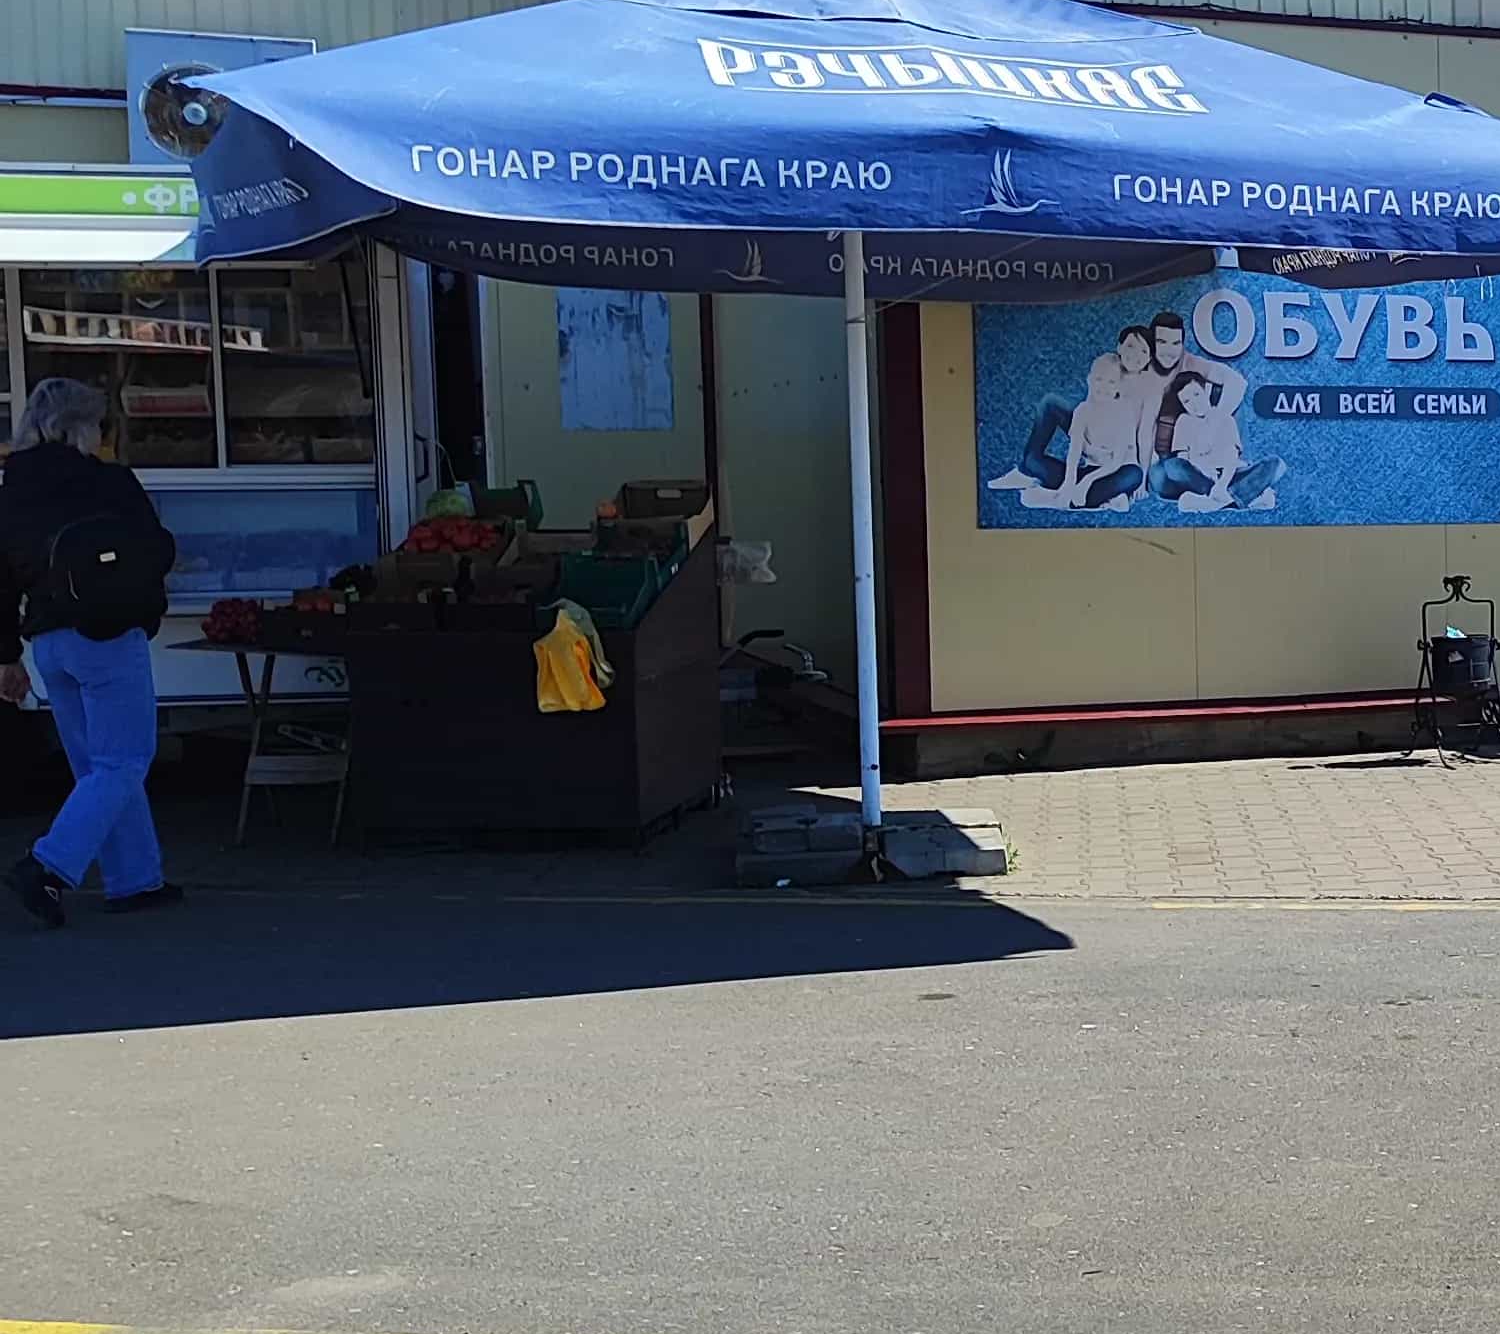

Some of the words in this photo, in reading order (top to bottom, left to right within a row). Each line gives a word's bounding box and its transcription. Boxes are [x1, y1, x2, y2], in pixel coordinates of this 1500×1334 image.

[411, 144, 556, 180] ГОНАР
[569, 150, 765, 190] РОДНАГА
[778, 159, 892, 191] КРАЮ
[1113, 174, 1232, 208] ГОНАР
[1242, 181, 1401, 217] РОДНАГА
[1192, 288, 1496, 362] ОБУВЬ
[1273, 392, 1321, 415] ДЛЯ
[1338, 388, 1396, 415] ВСЕЙ
[1413, 393, 1487, 415] СЕМЬИ
